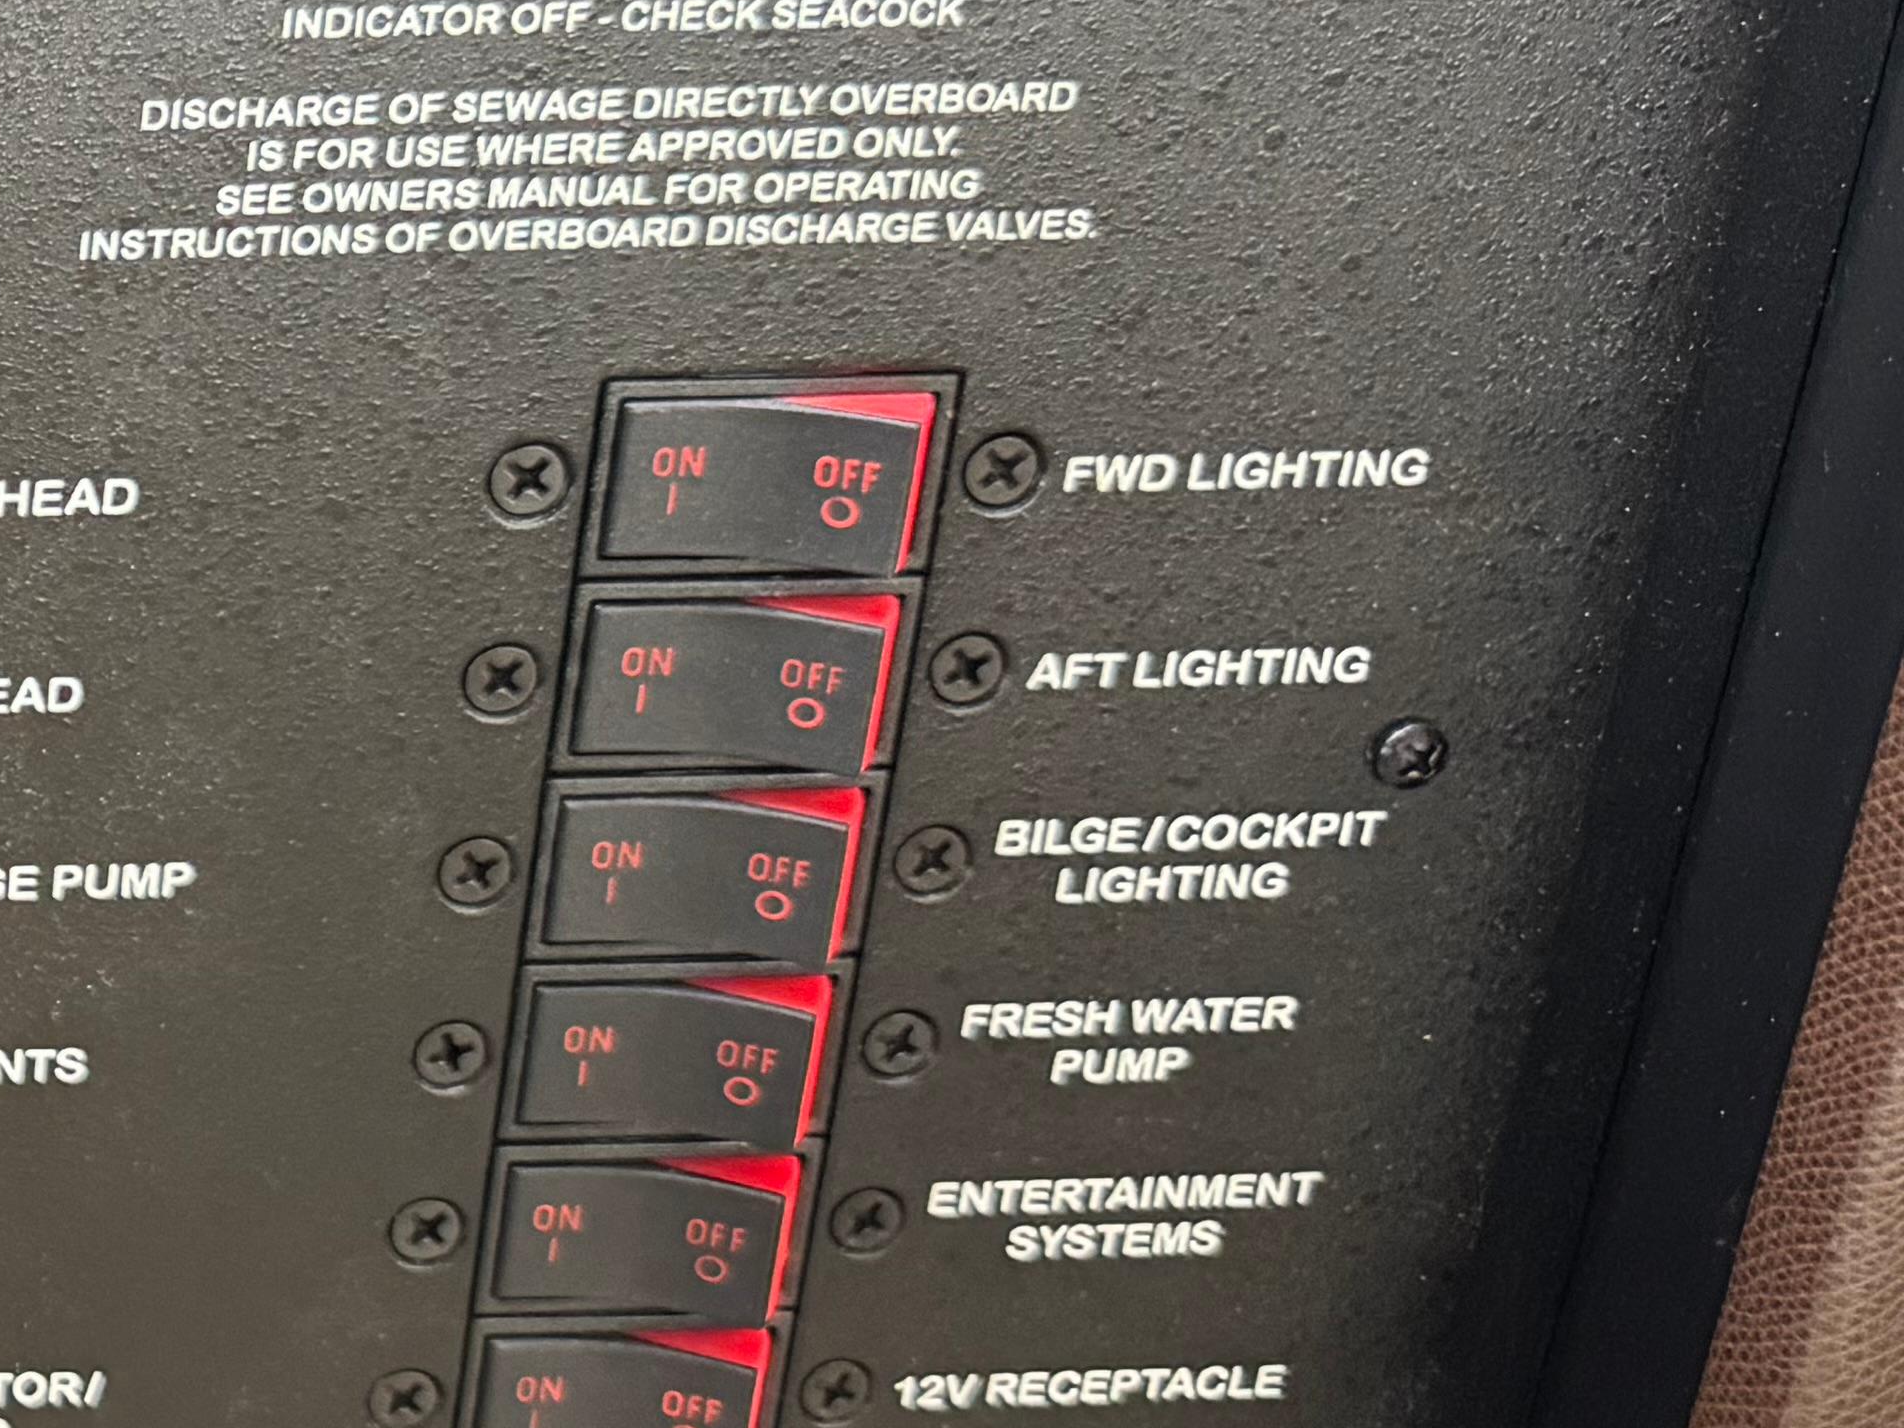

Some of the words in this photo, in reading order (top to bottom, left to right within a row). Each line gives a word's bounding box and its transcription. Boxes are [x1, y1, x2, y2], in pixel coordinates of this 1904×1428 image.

[281, 1, 506, 39] INDICATOR
[510, 0, 593, 35] OFF
[140, 92, 381, 131] DISCHARGE
[388, 91, 447, 125] OF
[451, 87, 628, 123] SEWAGE
[632, 84, 828, 120] DIRECTLY
[830, 80, 1080, 116] OVERBOARD
[247, 139, 286, 172] IS
[293, 136, 378, 171] FOR
[385, 133, 470, 168] USE
[476, 131, 625, 166] WHERE
[627, 126, 848, 162] APPROVED
[853, 125, 961, 158] ONLY.
[216, 182, 296, 217] SEE
[301, 177, 482, 213] OWNERS
[487, 175, 656, 209] MANUAL
[664, 171, 748, 205] FOR
[753, 168, 983, 204] OPERATING
[79, 223, 379, 261] INSTRUCTIONS
[385, 221, 442, 254] OF
[448, 215, 701, 252] OVERBOARD
[705, 210, 939, 246] DISCHARGE
[946, 207, 1098, 241] VALVES.
[653, 447, 707, 478] ON
[814, 456, 882, 493] OFF
[1063, 453, 1179, 493] FWD
[1187, 447, 1430, 491] LIGHTING
[621, 647, 676, 679] ON
[781, 659, 842, 695] OFF
[1026, 652, 1131, 690] AFT
[1133, 645, 1371, 688] LIGHTING
[994, 810, 1388, 856] BILGE/COCKPIT
[592, 841, 643, 871] ON
[748, 853, 810, 888] OFF
[52, 861, 196, 900] PUMP
[1055, 861, 1290, 904] LIGHTING
[960, 999, 1122, 1038] FRESH
[1131, 995, 1299, 1034] WATER
[564, 1026, 616, 1054] ON
[717, 1040, 777, 1075] OFF
[1050, 1046, 1190, 1084] PUMP
[927, 1171, 1324, 1218] ENTERTAINMENT
[533, 1204, 583, 1234] ON
[686, 1218, 745, 1253] OFF
[1005, 1219, 1224, 1261] SYSTEMS
[517, 1377, 566, 1404] ON
[894, 1373, 982, 1410] 12V
[985, 1364, 1287, 1407] RECEPTACLE
[662, 1391, 722, 1424] OFF
